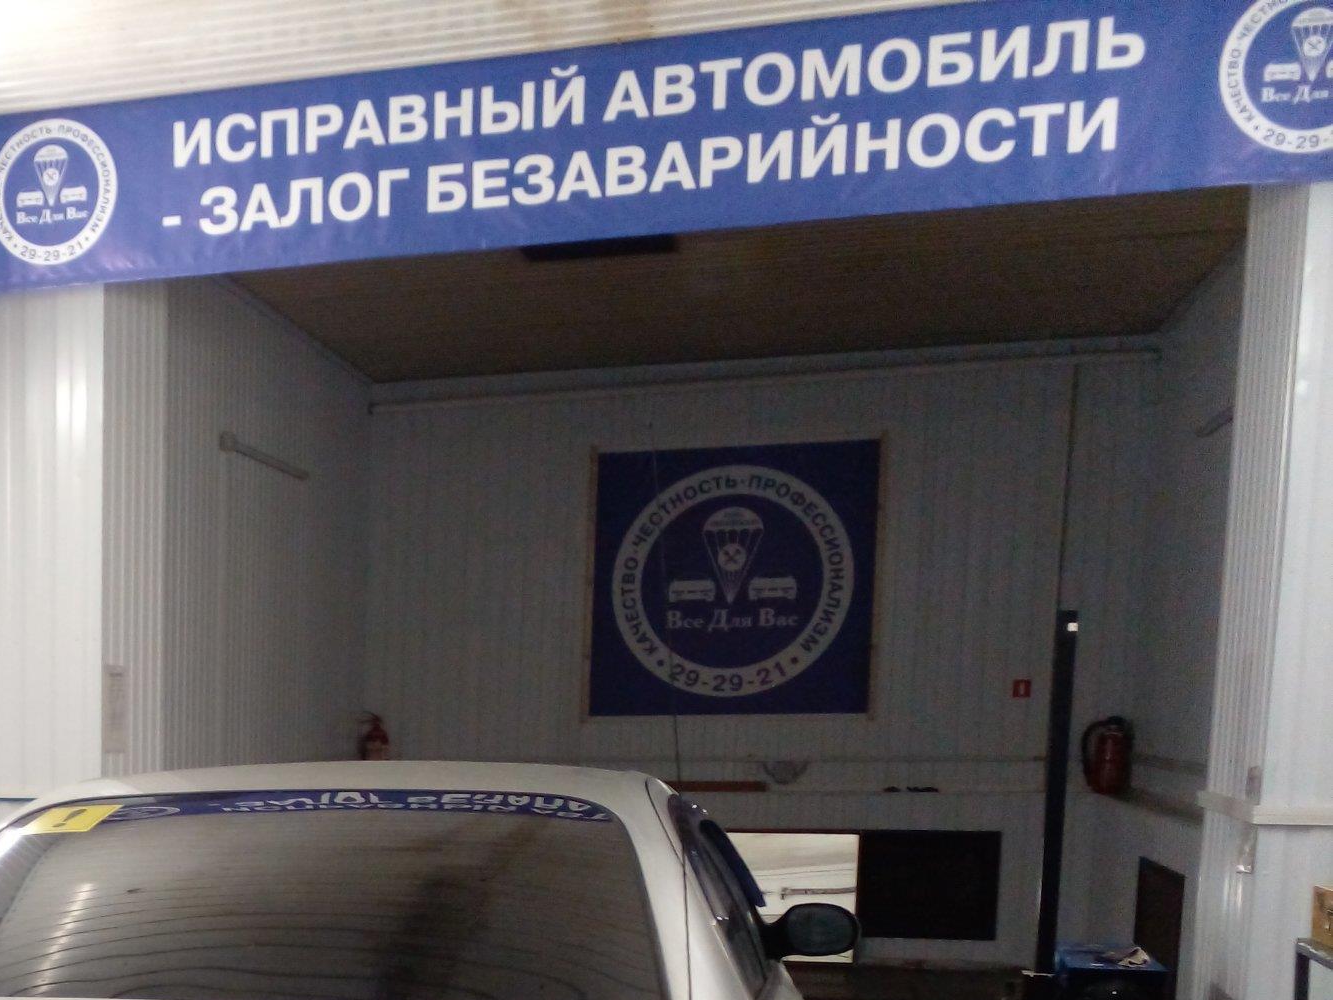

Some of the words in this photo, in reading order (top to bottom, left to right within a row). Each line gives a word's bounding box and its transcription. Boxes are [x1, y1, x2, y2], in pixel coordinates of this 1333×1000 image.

[172, 64, 586, 169] ИСПРАВНЫЙ
[603, 16, 1146, 122] АВТОМОБИЛЬ
[199, 168, 412, 236] ЗАЛОГ
[426, 97, 1120, 215] БЕЗАВАРИЙНОСТИ
[20, 242, 84, 262] 29-29-21
[633, 475, 738, 548] ЧЕСТНОСТЬ
[747, 473, 845, 653] ПРОФЕССИОНАЛИЗМ
[620, 556, 658, 660] КАЧЕСТВО
[667, 610, 705, 630] Все
[708, 608, 752, 632] Для
[758, 607, 799, 627] Вас
[669, 661, 787, 692] 29-29-21
